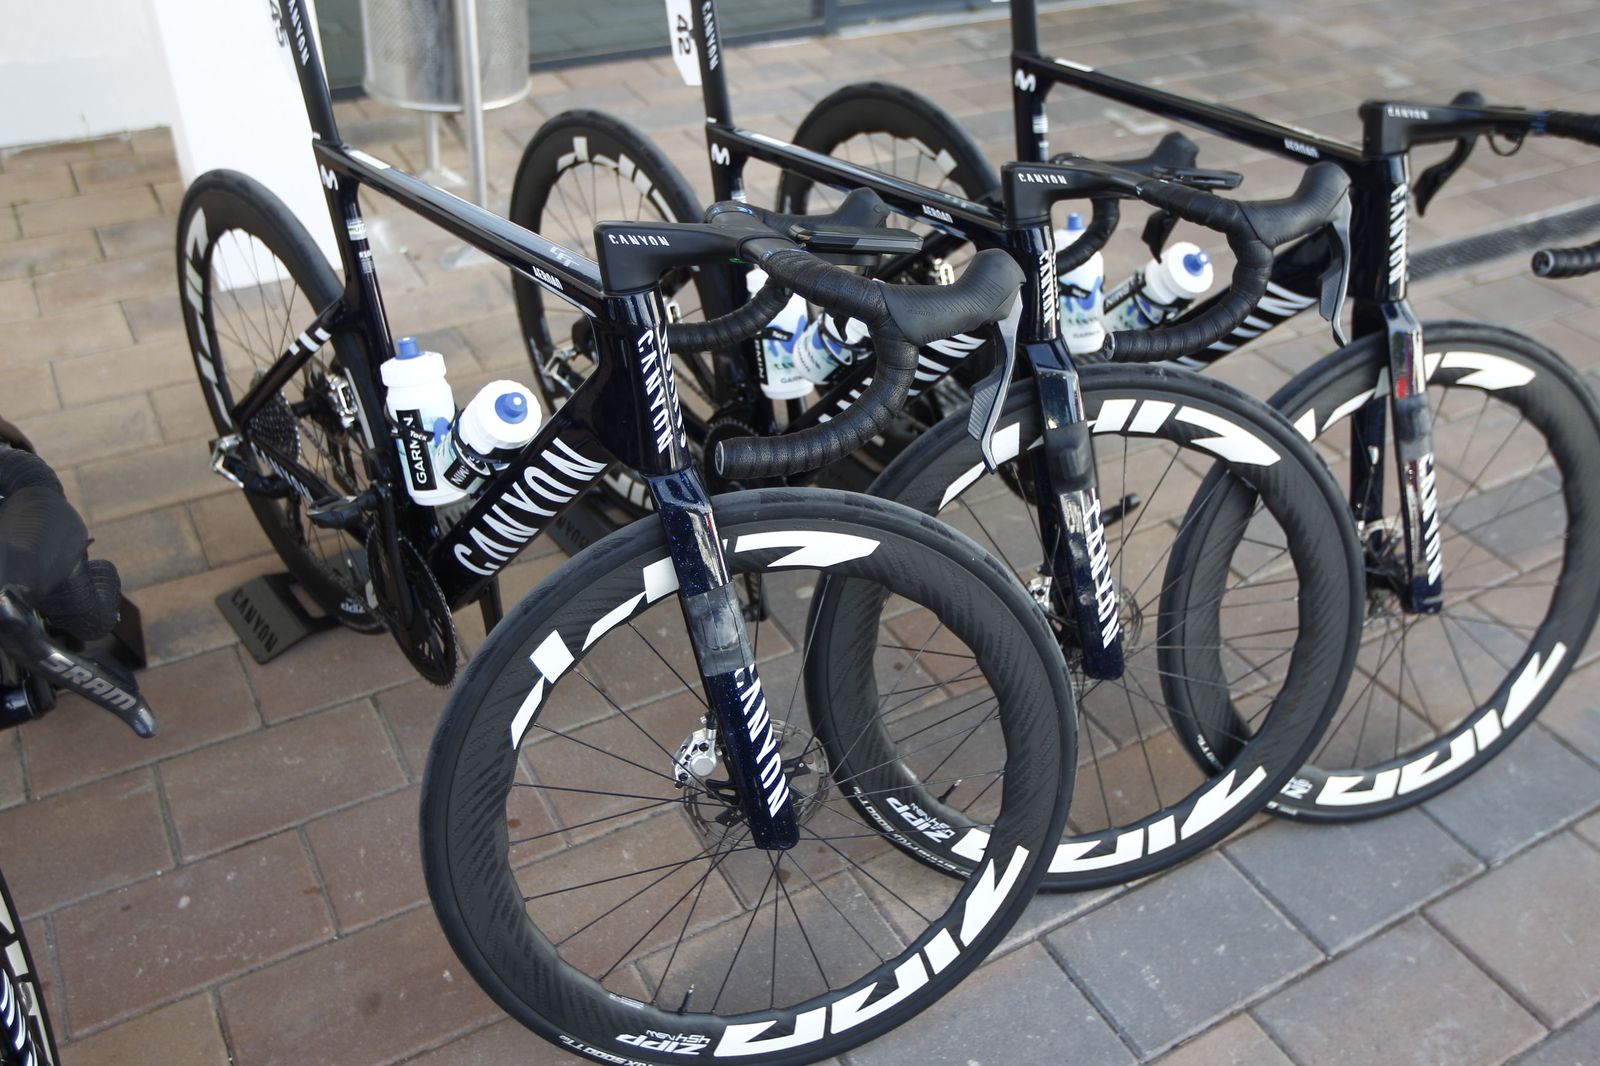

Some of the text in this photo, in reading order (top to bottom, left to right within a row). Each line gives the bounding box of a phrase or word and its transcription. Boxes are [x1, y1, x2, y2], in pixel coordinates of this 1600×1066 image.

[677, 14, 691, 55] 42
[702, 1, 719, 71] CANYON
[1387, 104, 1429, 120] CANYON
[1018, 173, 1068, 185] CANYON
[922, 204, 954, 224] AEROAD
[1389, 183, 1408, 285] CANYON
[608, 234, 670, 247] CANYON
[532, 266, 563, 290] AEROAD
[1039, 250, 1054, 325] CANYON
[637, 329, 673, 454] CANYON
[454, 437, 607, 576] CANYON
[1083, 499, 1120, 649] CANYON
[231, 588, 278, 653] CANYON
[40, 652, 137, 711] SRAM
[886, 797, 951, 843] ZIPP
[583, 1048, 628, 1064] 5000
[615, 1034, 708, 1055] ZIPP
